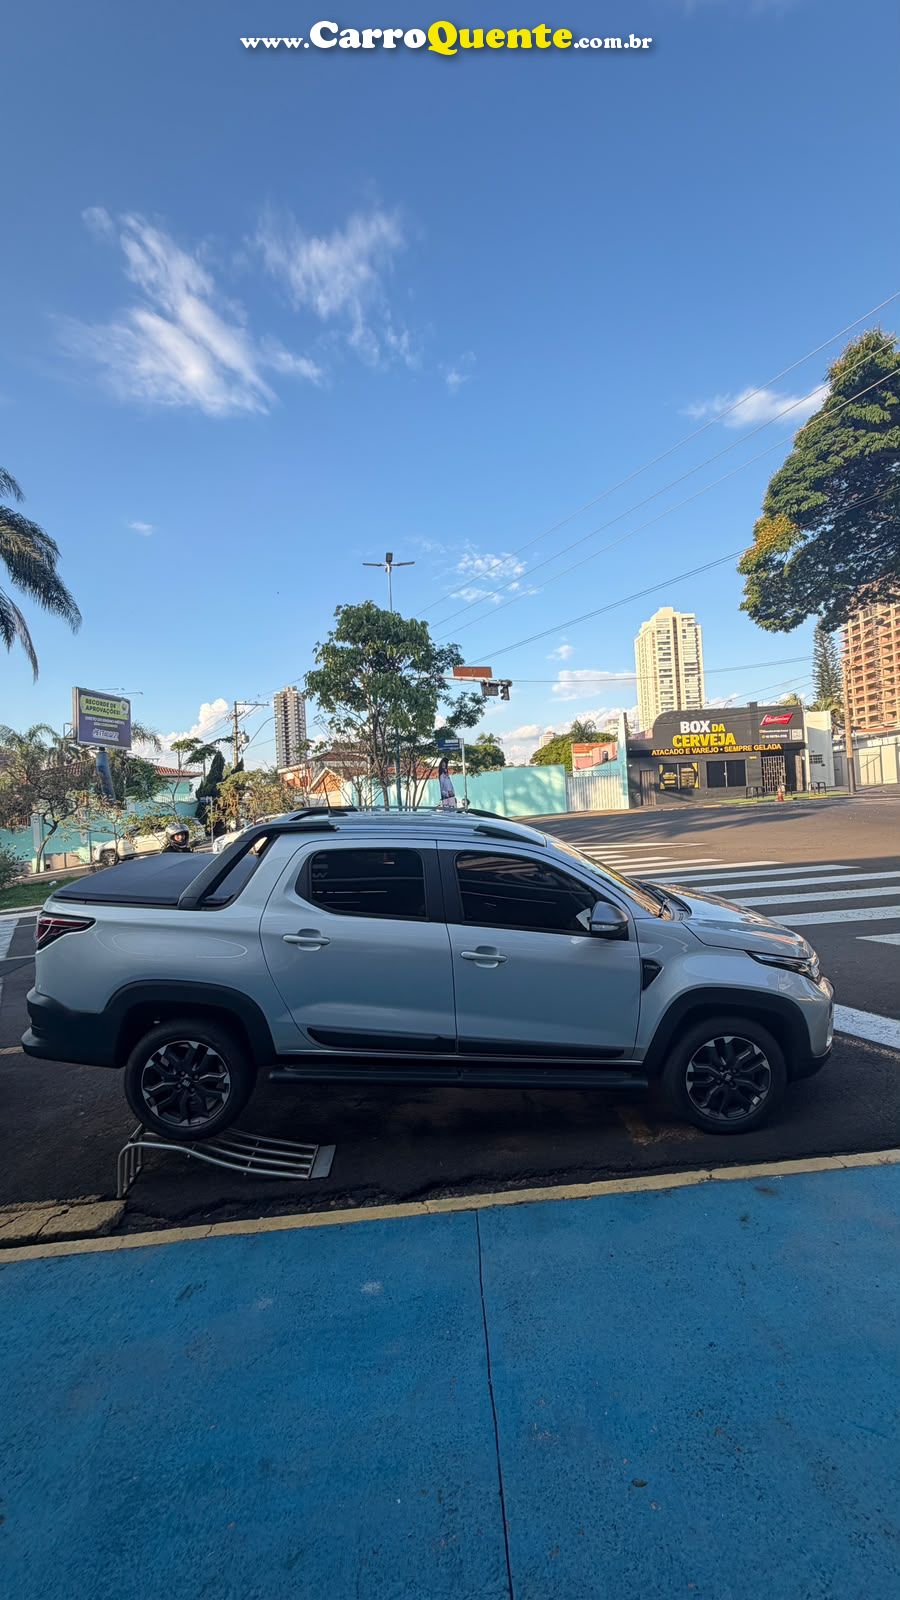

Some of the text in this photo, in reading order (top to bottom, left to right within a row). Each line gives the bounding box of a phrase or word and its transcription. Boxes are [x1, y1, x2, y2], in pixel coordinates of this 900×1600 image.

[85, 698, 109, 707] RECORDE
[680, 720, 726, 734] BOX DA
[672, 732, 737, 748] CERVEJA
[651, 747, 684, 756] ATACADO
[723, 745, 753, 753] SEMPRE
[753, 743, 782, 752] GELADA
